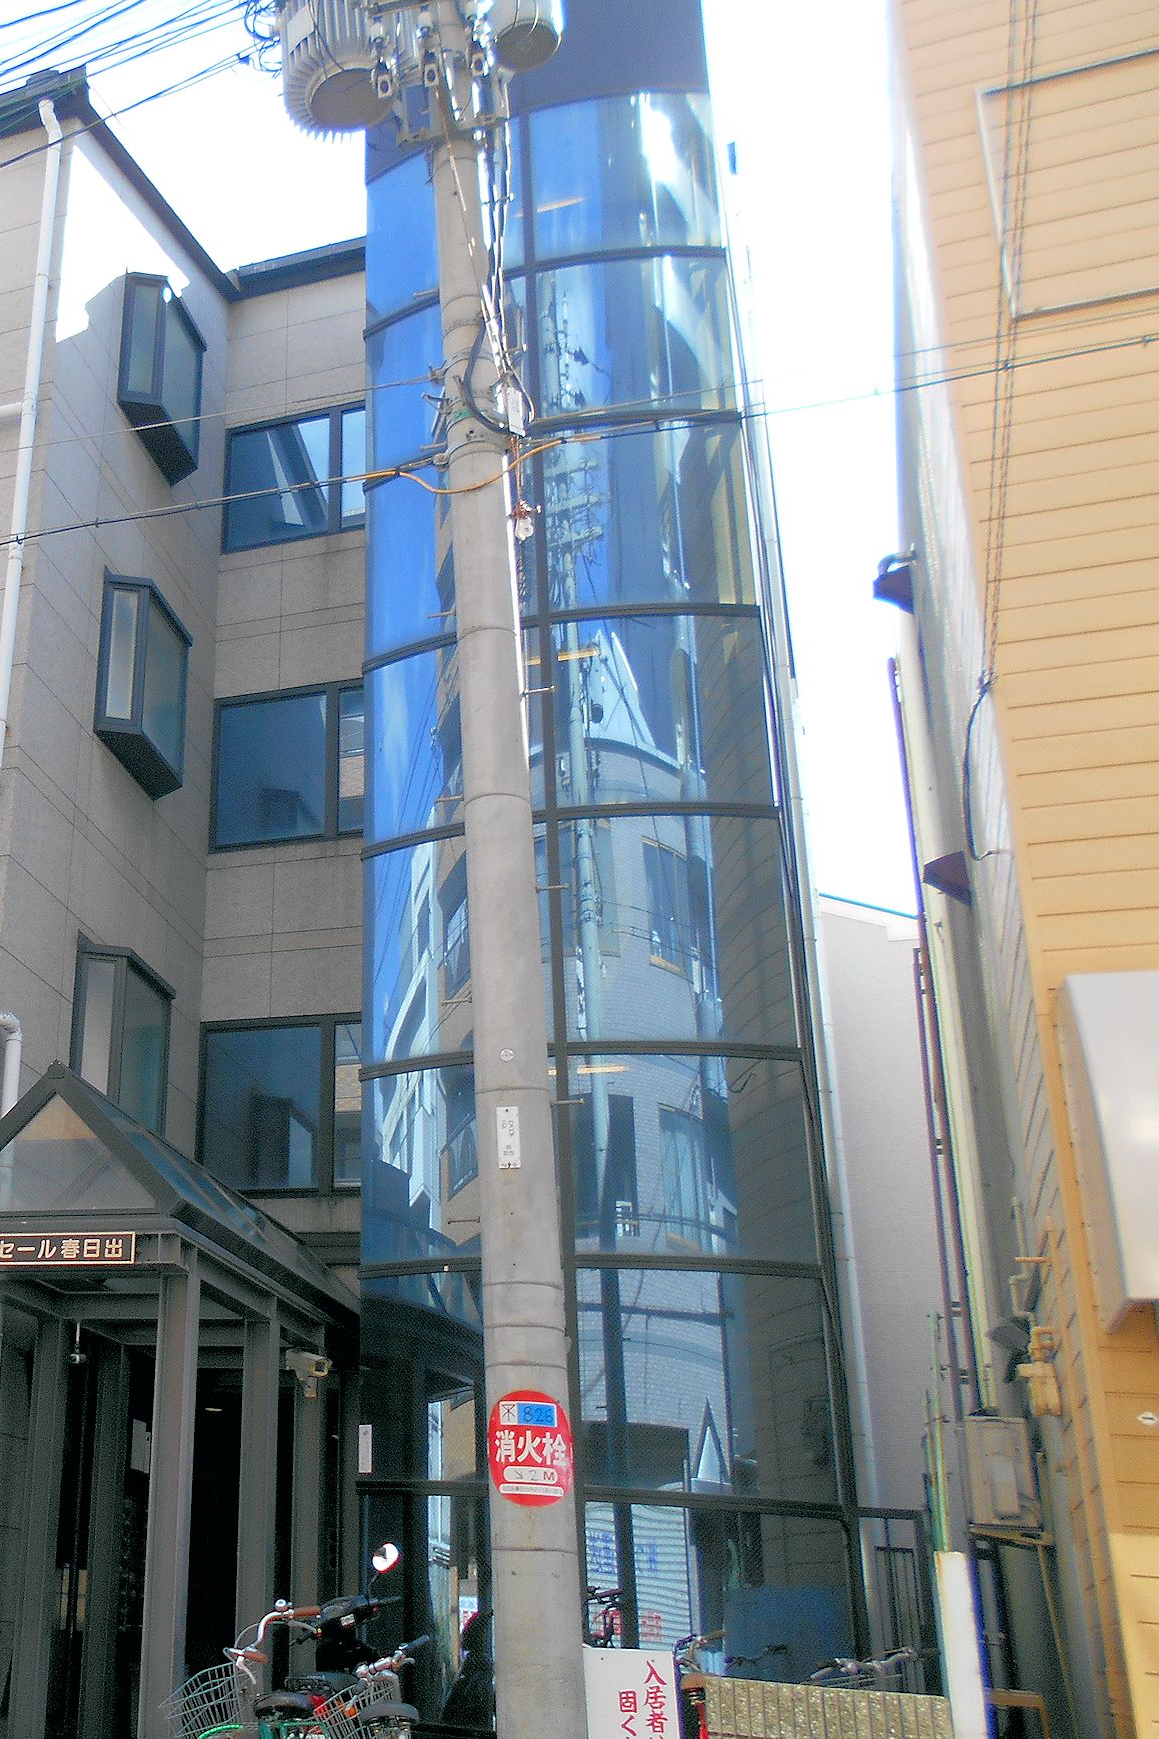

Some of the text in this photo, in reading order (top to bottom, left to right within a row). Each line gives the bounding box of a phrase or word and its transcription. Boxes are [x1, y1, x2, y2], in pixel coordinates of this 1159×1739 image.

[495, 1430, 567, 1467] 消火栓
[618, 1690, 638, 1739] 固く
[644, 1661, 669, 1739] 入居者
